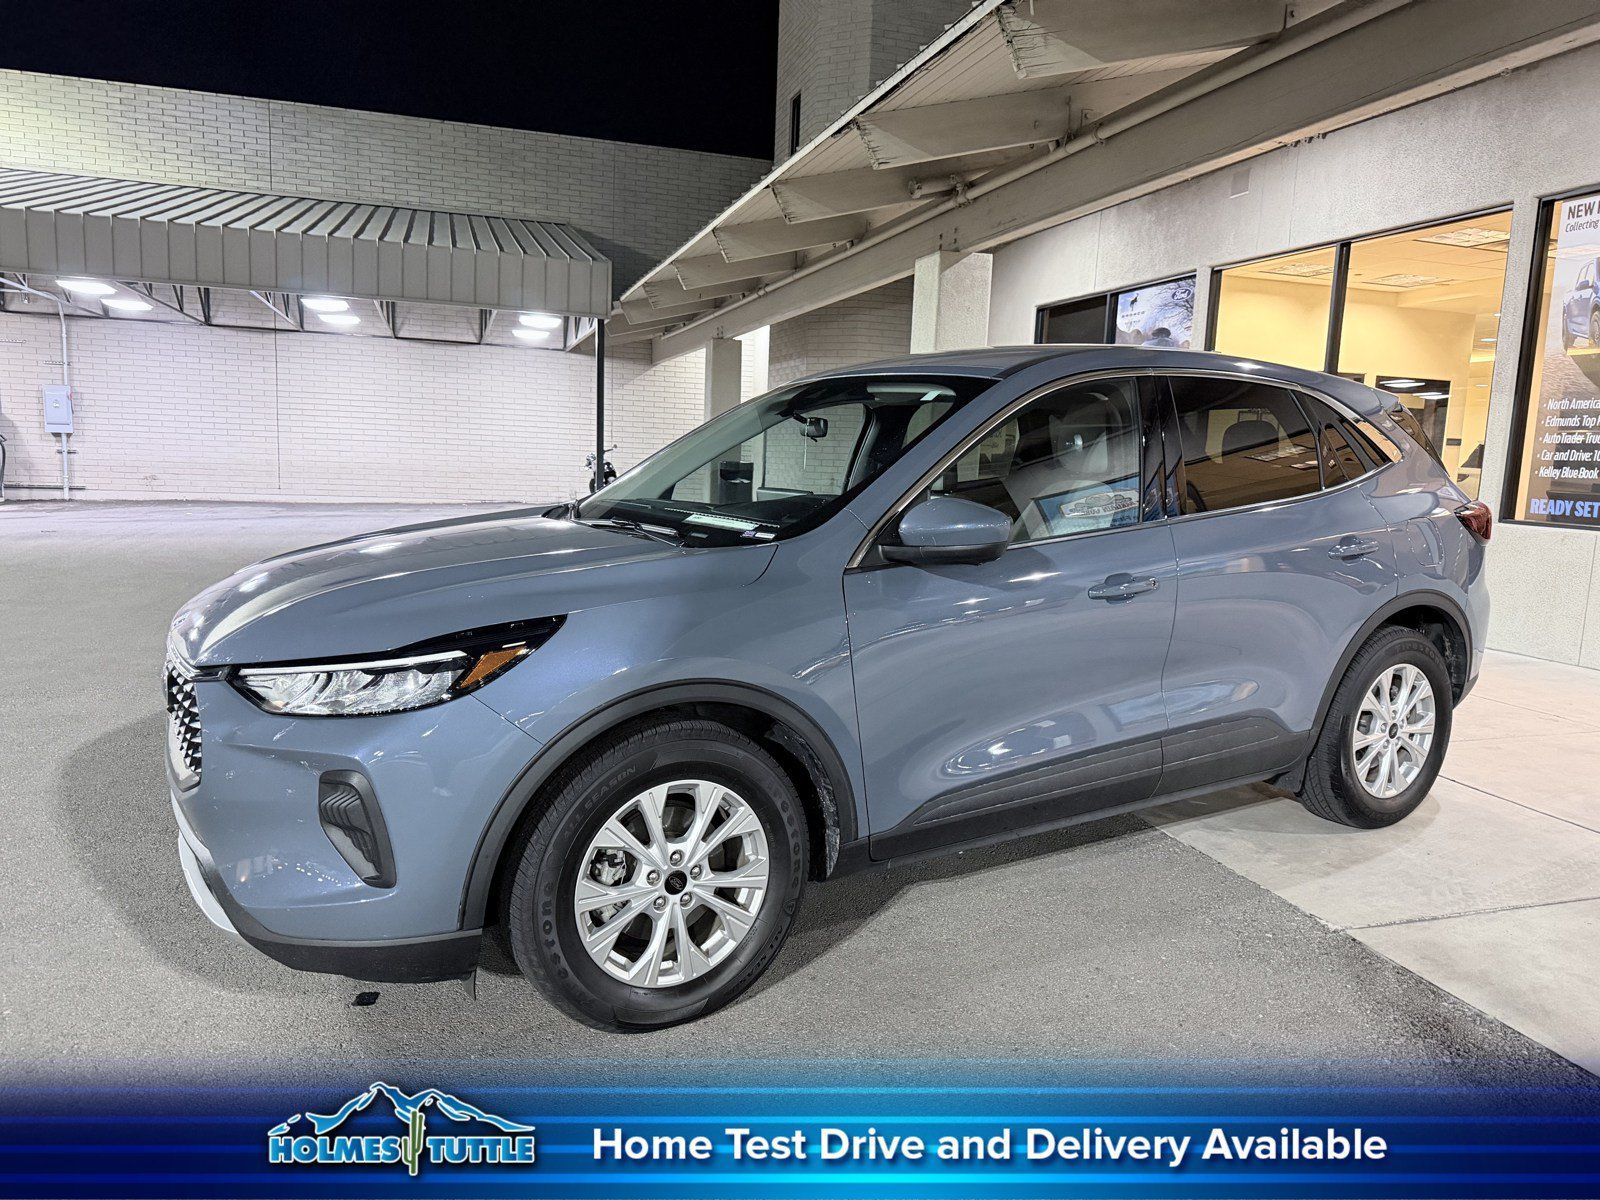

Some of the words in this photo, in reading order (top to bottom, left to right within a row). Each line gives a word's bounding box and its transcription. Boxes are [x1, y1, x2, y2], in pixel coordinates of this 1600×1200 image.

[1568, 201, 1596, 220] NEW
[1566, 219, 1599, 232] Collecting
[1548, 398, 1569, 410] North
[1545, 415, 1581, 427] Edmunds
[1582, 415, 1596, 428] Top
[1543, 432, 1585, 444] AutoTrader
[1541, 450, 1554, 461] Car
[1554, 450, 1570, 461] and
[1539, 466, 1561, 479] Kelley
[1561, 467, 1579, 478] Blue
[1579, 467, 1599, 479] Book
[1530, 498, 1574, 516] READY
[1574, 501, 1600, 518] SET
